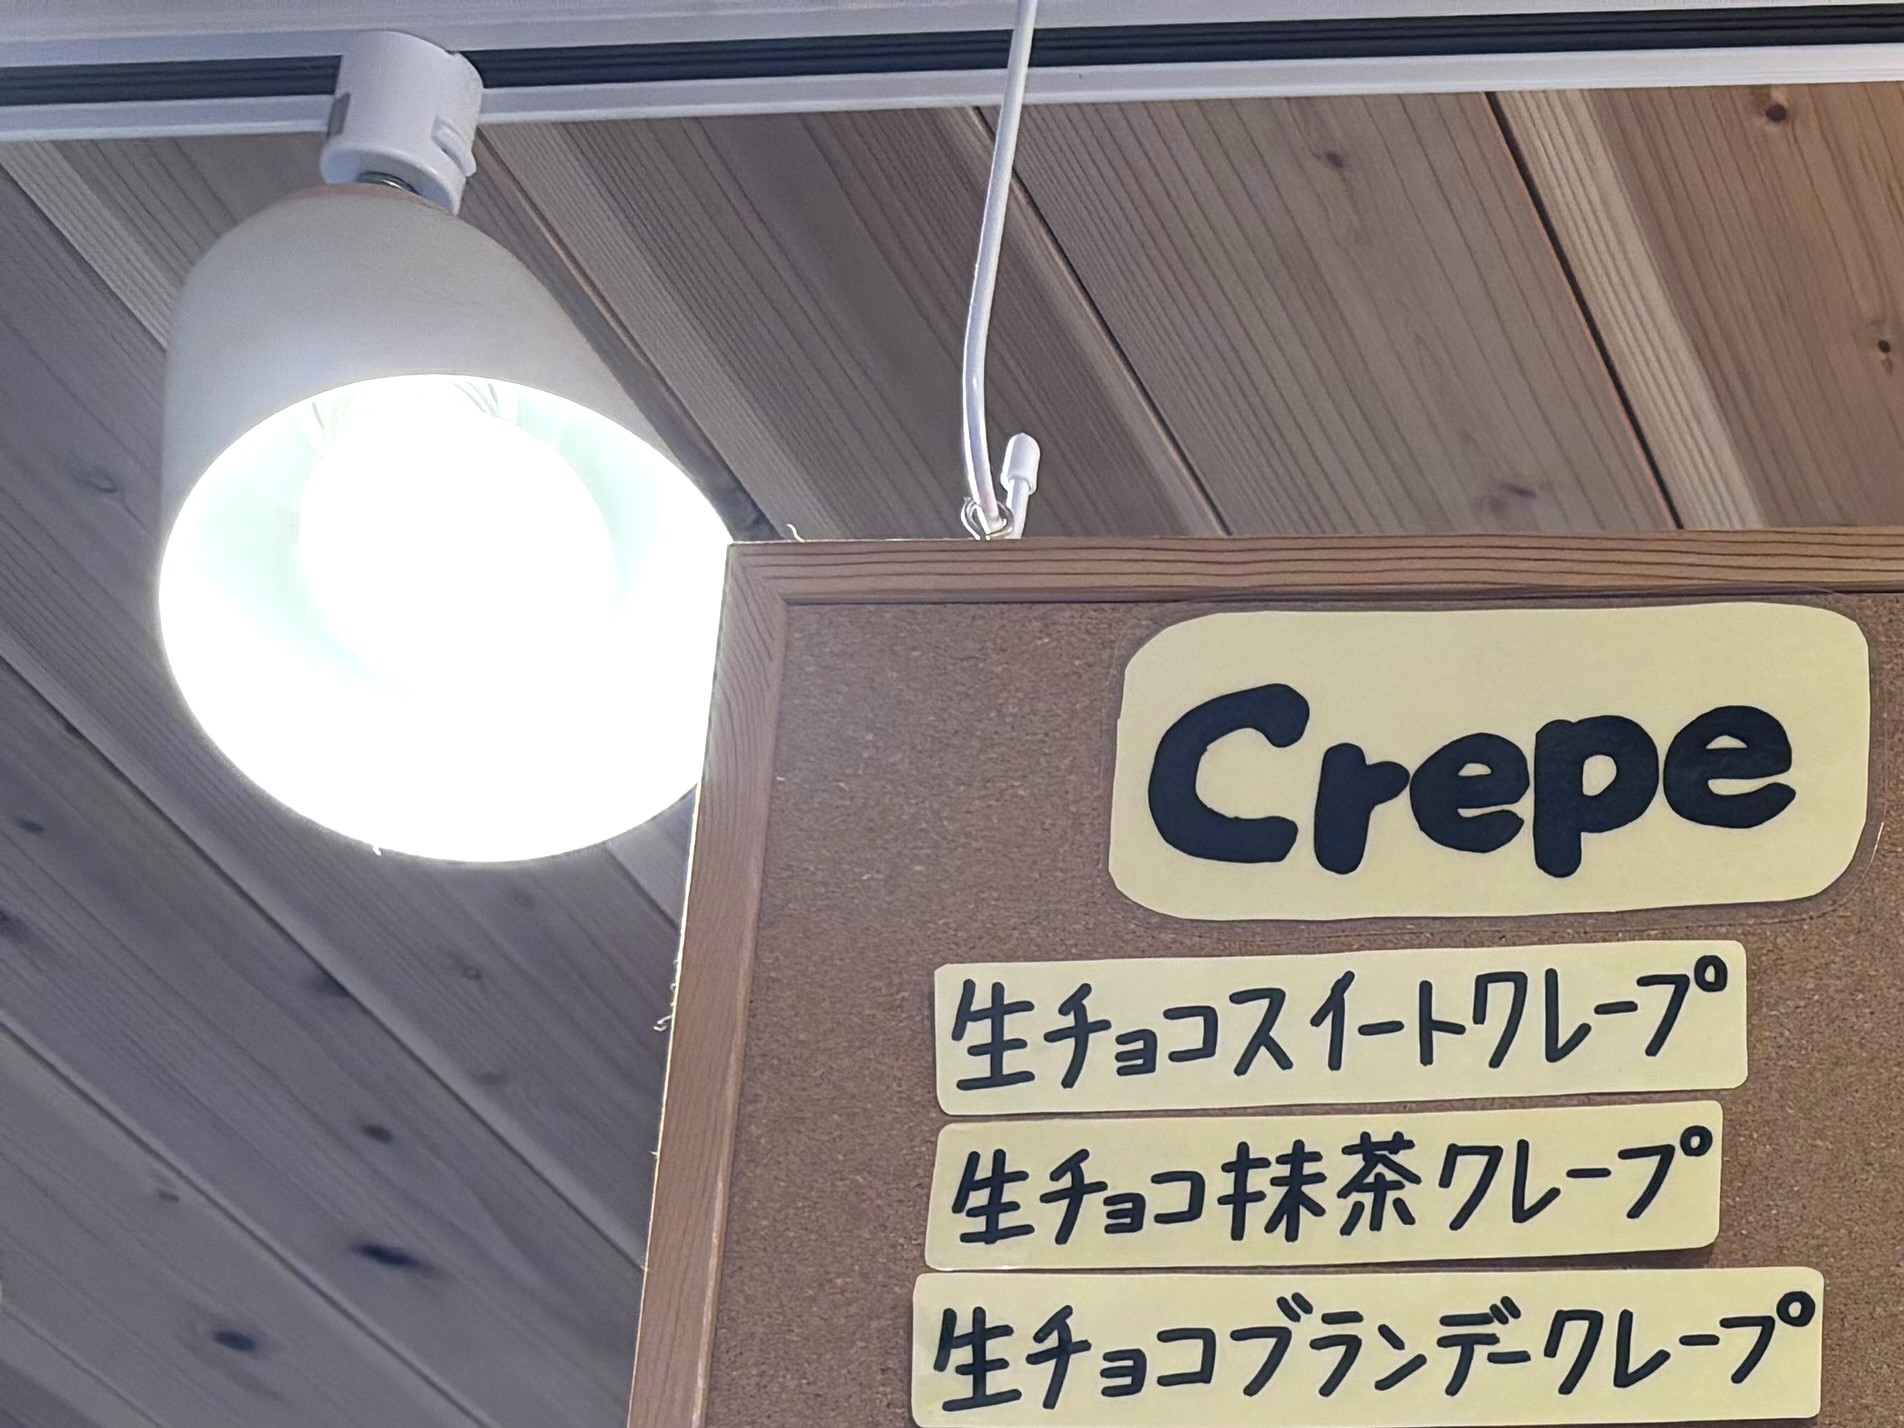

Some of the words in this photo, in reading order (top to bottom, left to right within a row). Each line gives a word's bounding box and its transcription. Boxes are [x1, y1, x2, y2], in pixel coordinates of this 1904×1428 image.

[1147, 683, 1797, 879] Crepe
[951, 953, 1728, 1091] 生チョコスイートクレープ
[951, 1125, 1713, 1245] 生チョコ抹茶クレープ
[933, 1290, 1816, 1412] 生チョコブランデークレープ
